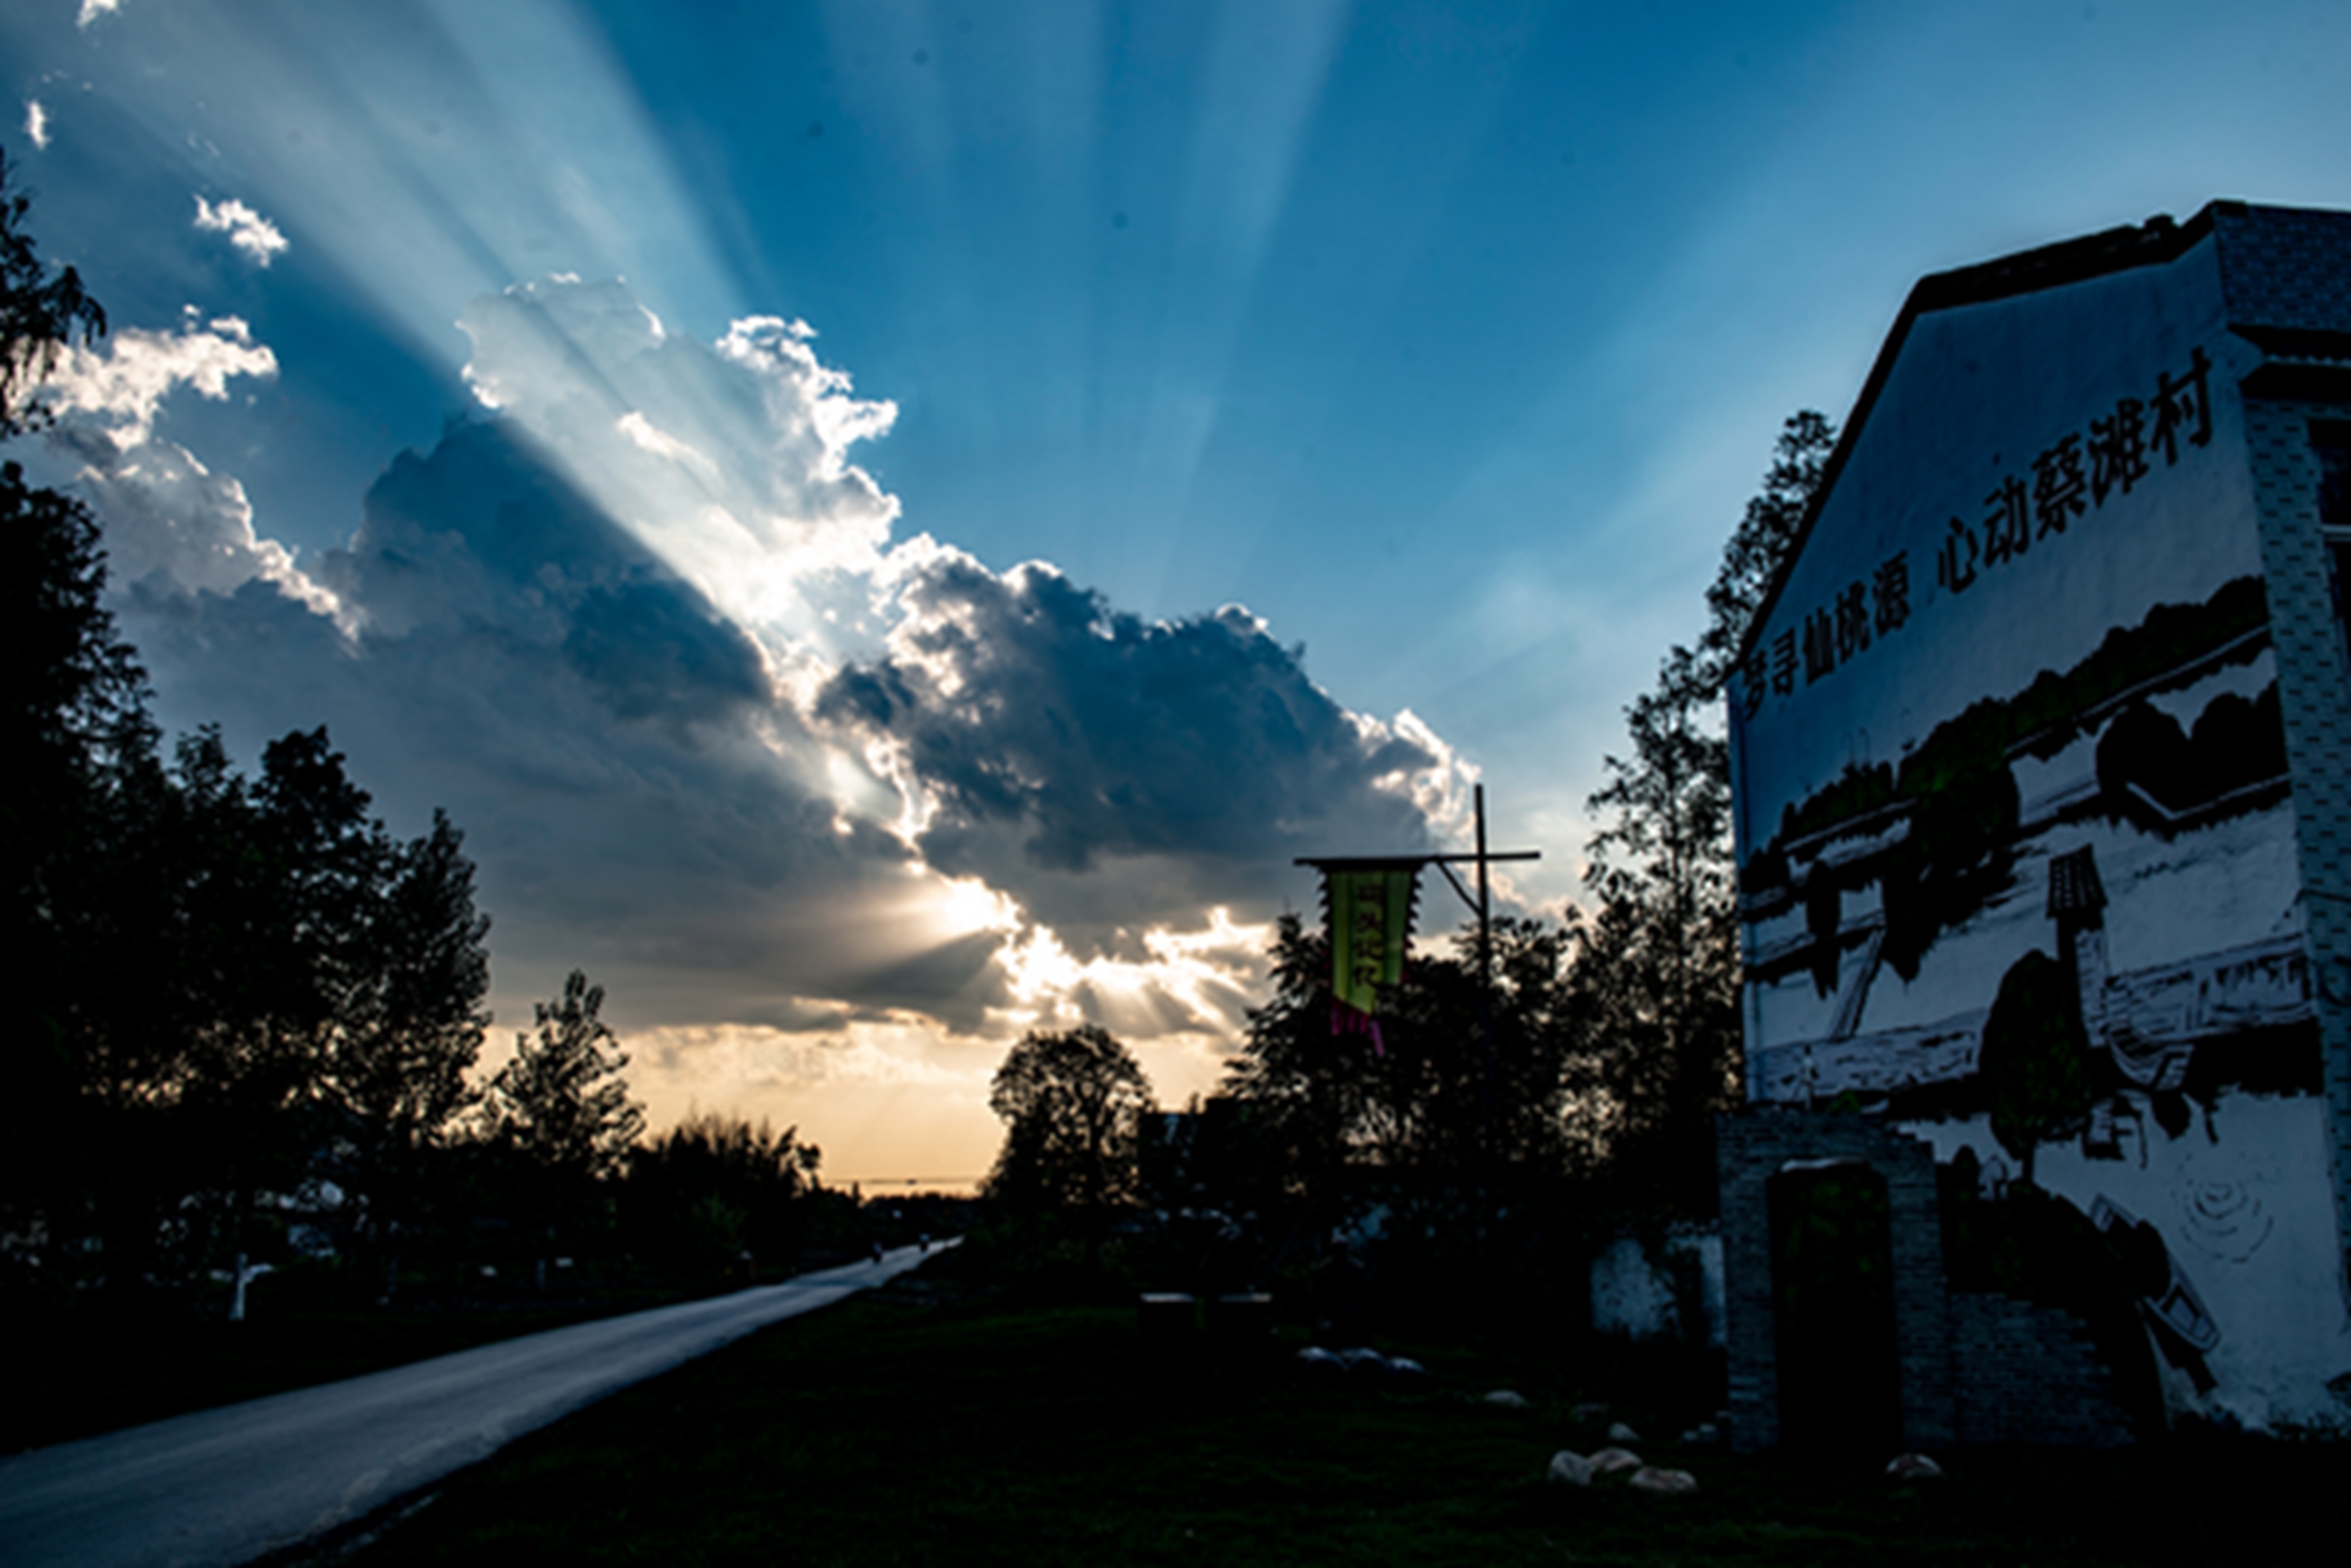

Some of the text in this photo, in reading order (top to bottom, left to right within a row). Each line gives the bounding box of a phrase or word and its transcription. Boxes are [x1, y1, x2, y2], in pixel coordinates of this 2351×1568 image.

[1936, 347, 2212, 593] 心动蔡滩村
